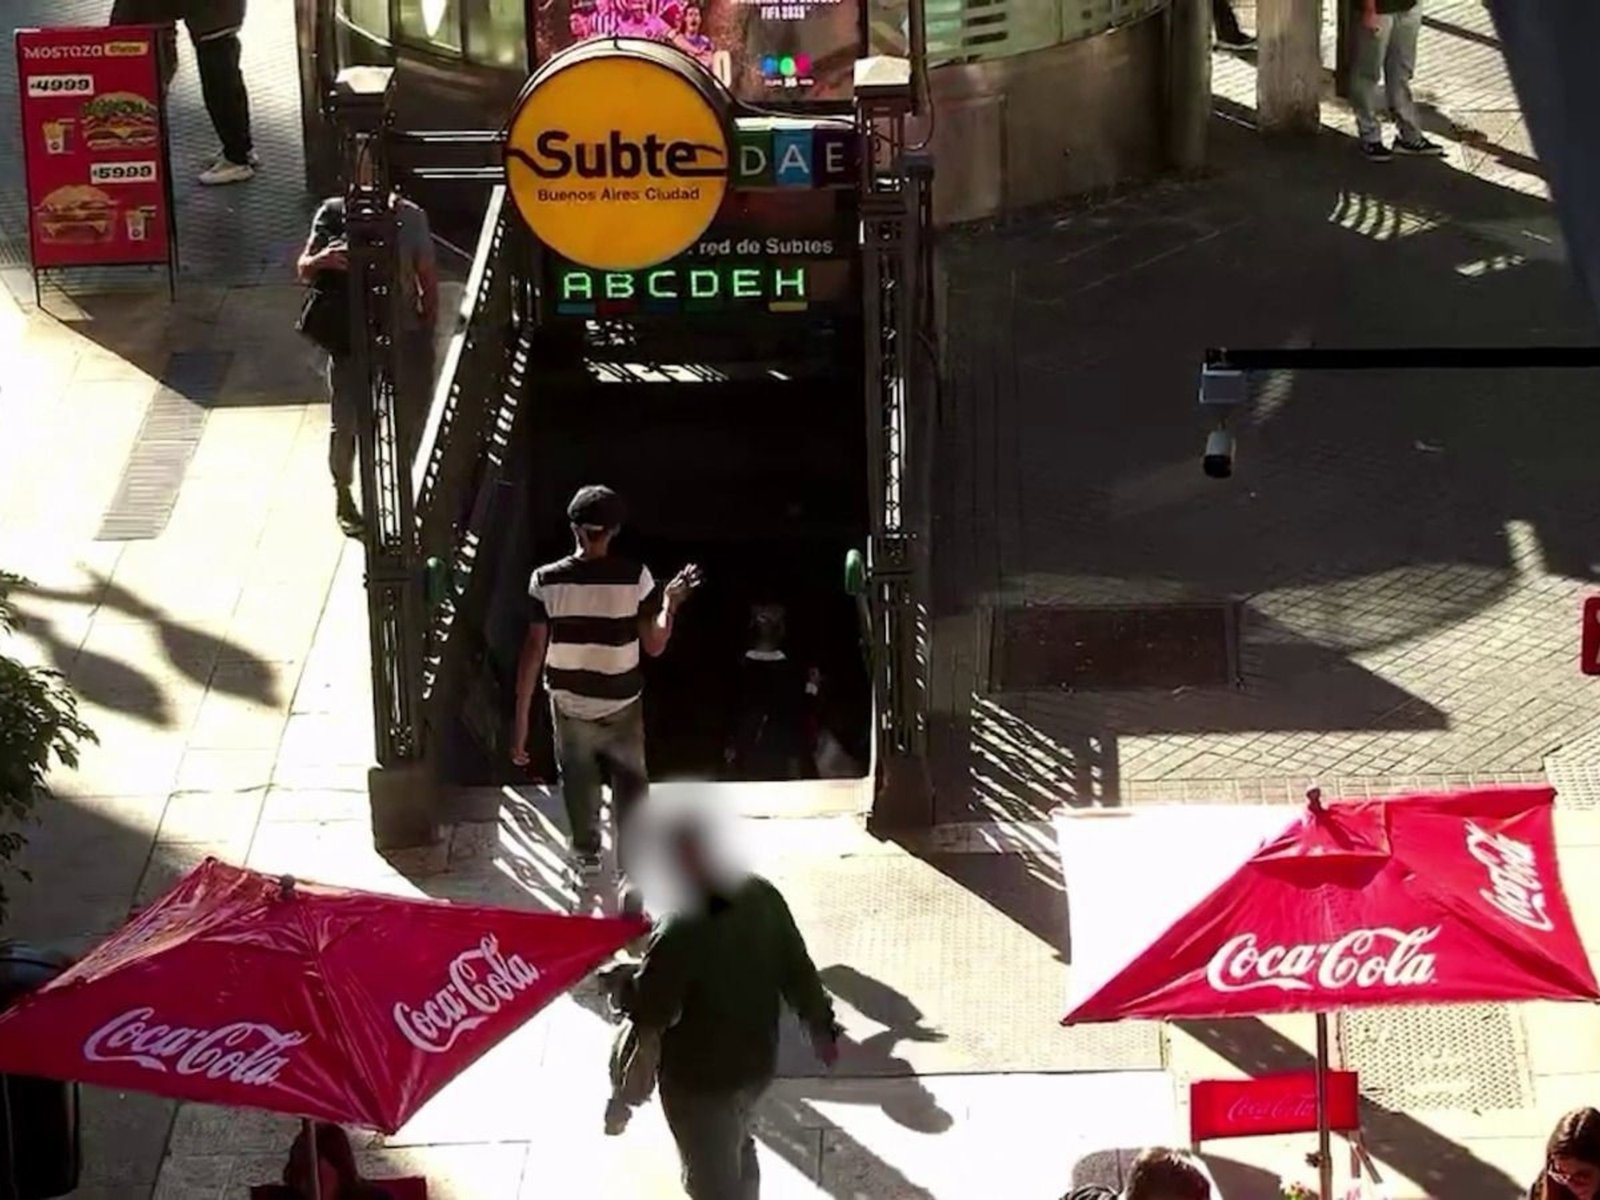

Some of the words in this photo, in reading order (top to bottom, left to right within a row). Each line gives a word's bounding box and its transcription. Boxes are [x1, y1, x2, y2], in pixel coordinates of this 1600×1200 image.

[23, 45, 103, 59] MOSTAZA
[535, 129, 700, 179] Subte
[537, 188, 597, 202] Buenos
[601, 188, 640, 201] Aires
[645, 187, 700, 201] Ciudad
[699, 239, 731, 257] red
[736, 238, 761, 254] de
[766, 237, 834, 255] Subtes
[1462, 817, 1554, 932] Coca-Cola
[1206, 924, 1440, 992] Coca-Cola
[394, 932, 541, 1054] Coca-Cola
[84, 1007, 308, 1086] Coca-Cola
